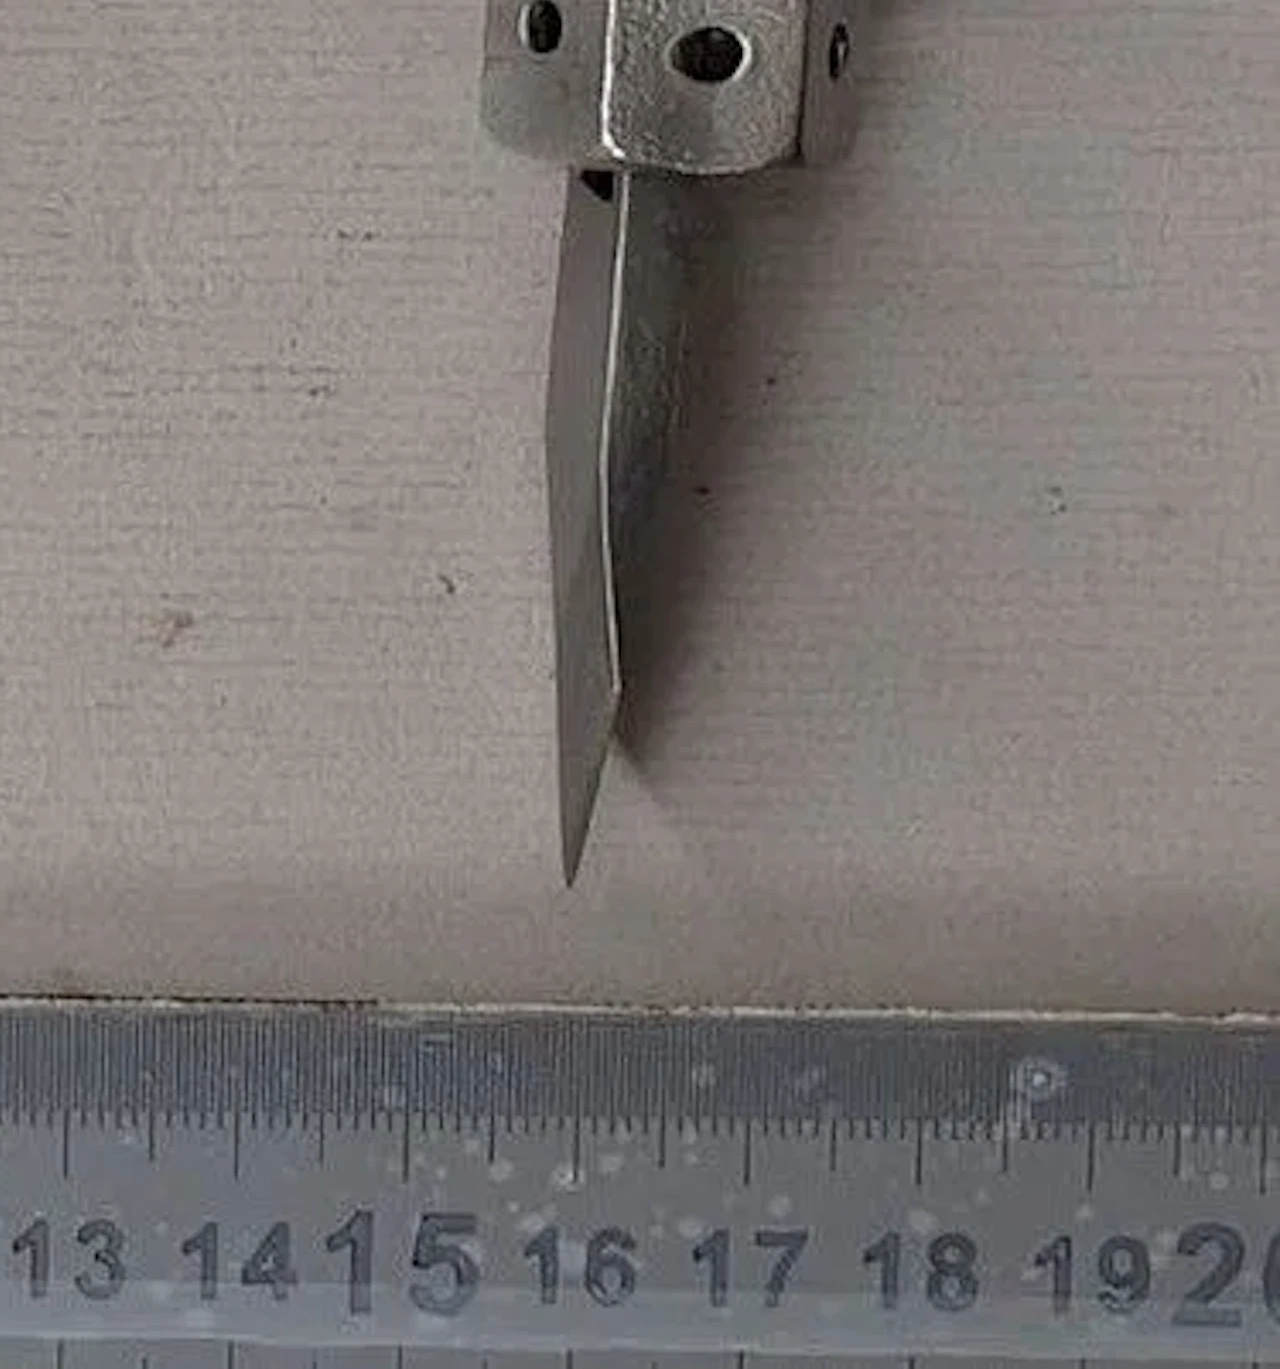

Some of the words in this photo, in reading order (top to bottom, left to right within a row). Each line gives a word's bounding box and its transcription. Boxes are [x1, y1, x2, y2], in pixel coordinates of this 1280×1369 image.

[11, 1219, 126, 1300] 13
[180, 1222, 297, 1301] 14
[325, 1210, 479, 1316] 15
[523, 1226, 637, 1307] 16
[691, 1230, 808, 1308] 17
[863, 1232, 979, 1311] 18
[1035, 1236, 1150, 1315] 19
